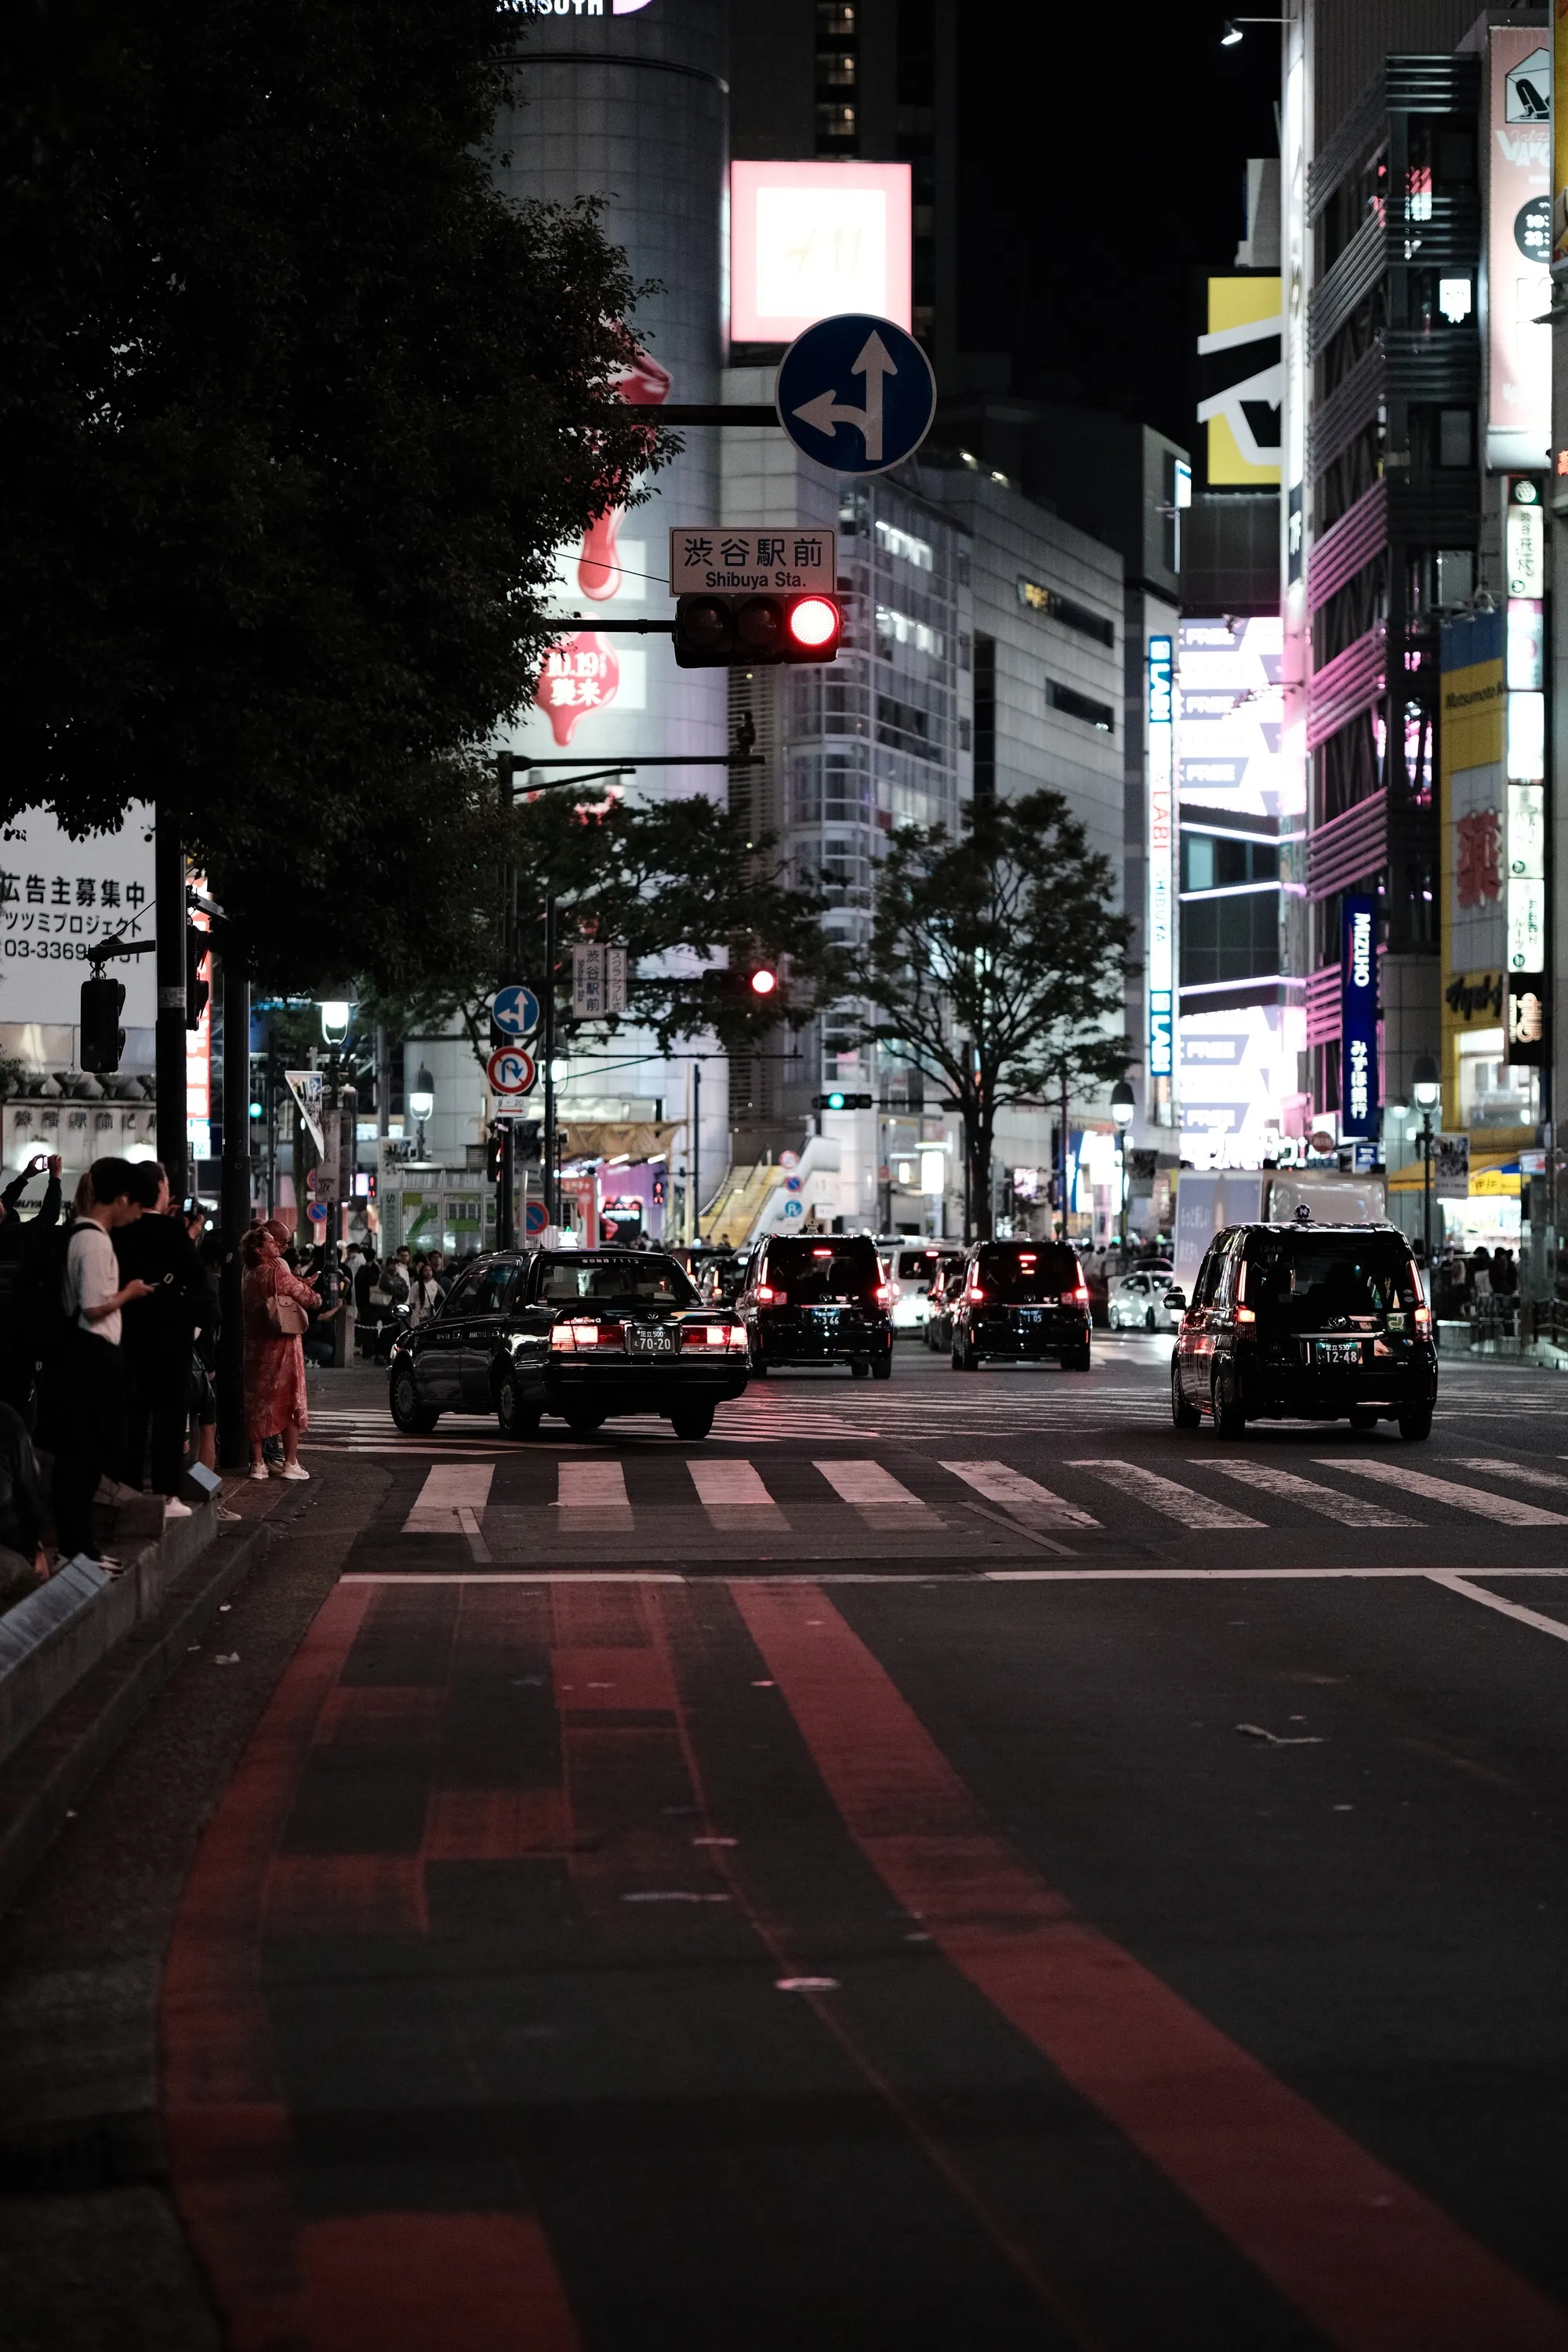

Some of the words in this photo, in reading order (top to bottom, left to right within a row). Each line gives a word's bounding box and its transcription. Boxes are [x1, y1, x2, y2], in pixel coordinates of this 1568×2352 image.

[684, 538, 822, 567] 渋谷駅前
[706, 572, 768, 590] Shibuya
[775, 572, 807, 587] Sta.
[1153, 792, 1170, 848] LABI
[2, 873, 144, 909] 広告主募集中
[5, 912, 142, 937] ツツミプロジェクト
[1353, 913, 1370, 987] MIZUHO
[586, 950, 599, 1011] 渋谷駅前
[612, 953, 622, 1010] スクランブル式
[1351, 1040, 1367, 1120] みずほ銀行
[640, 1338, 671, 1349] 70-20
[1327, 1352, 1357, 1363] 12-48
